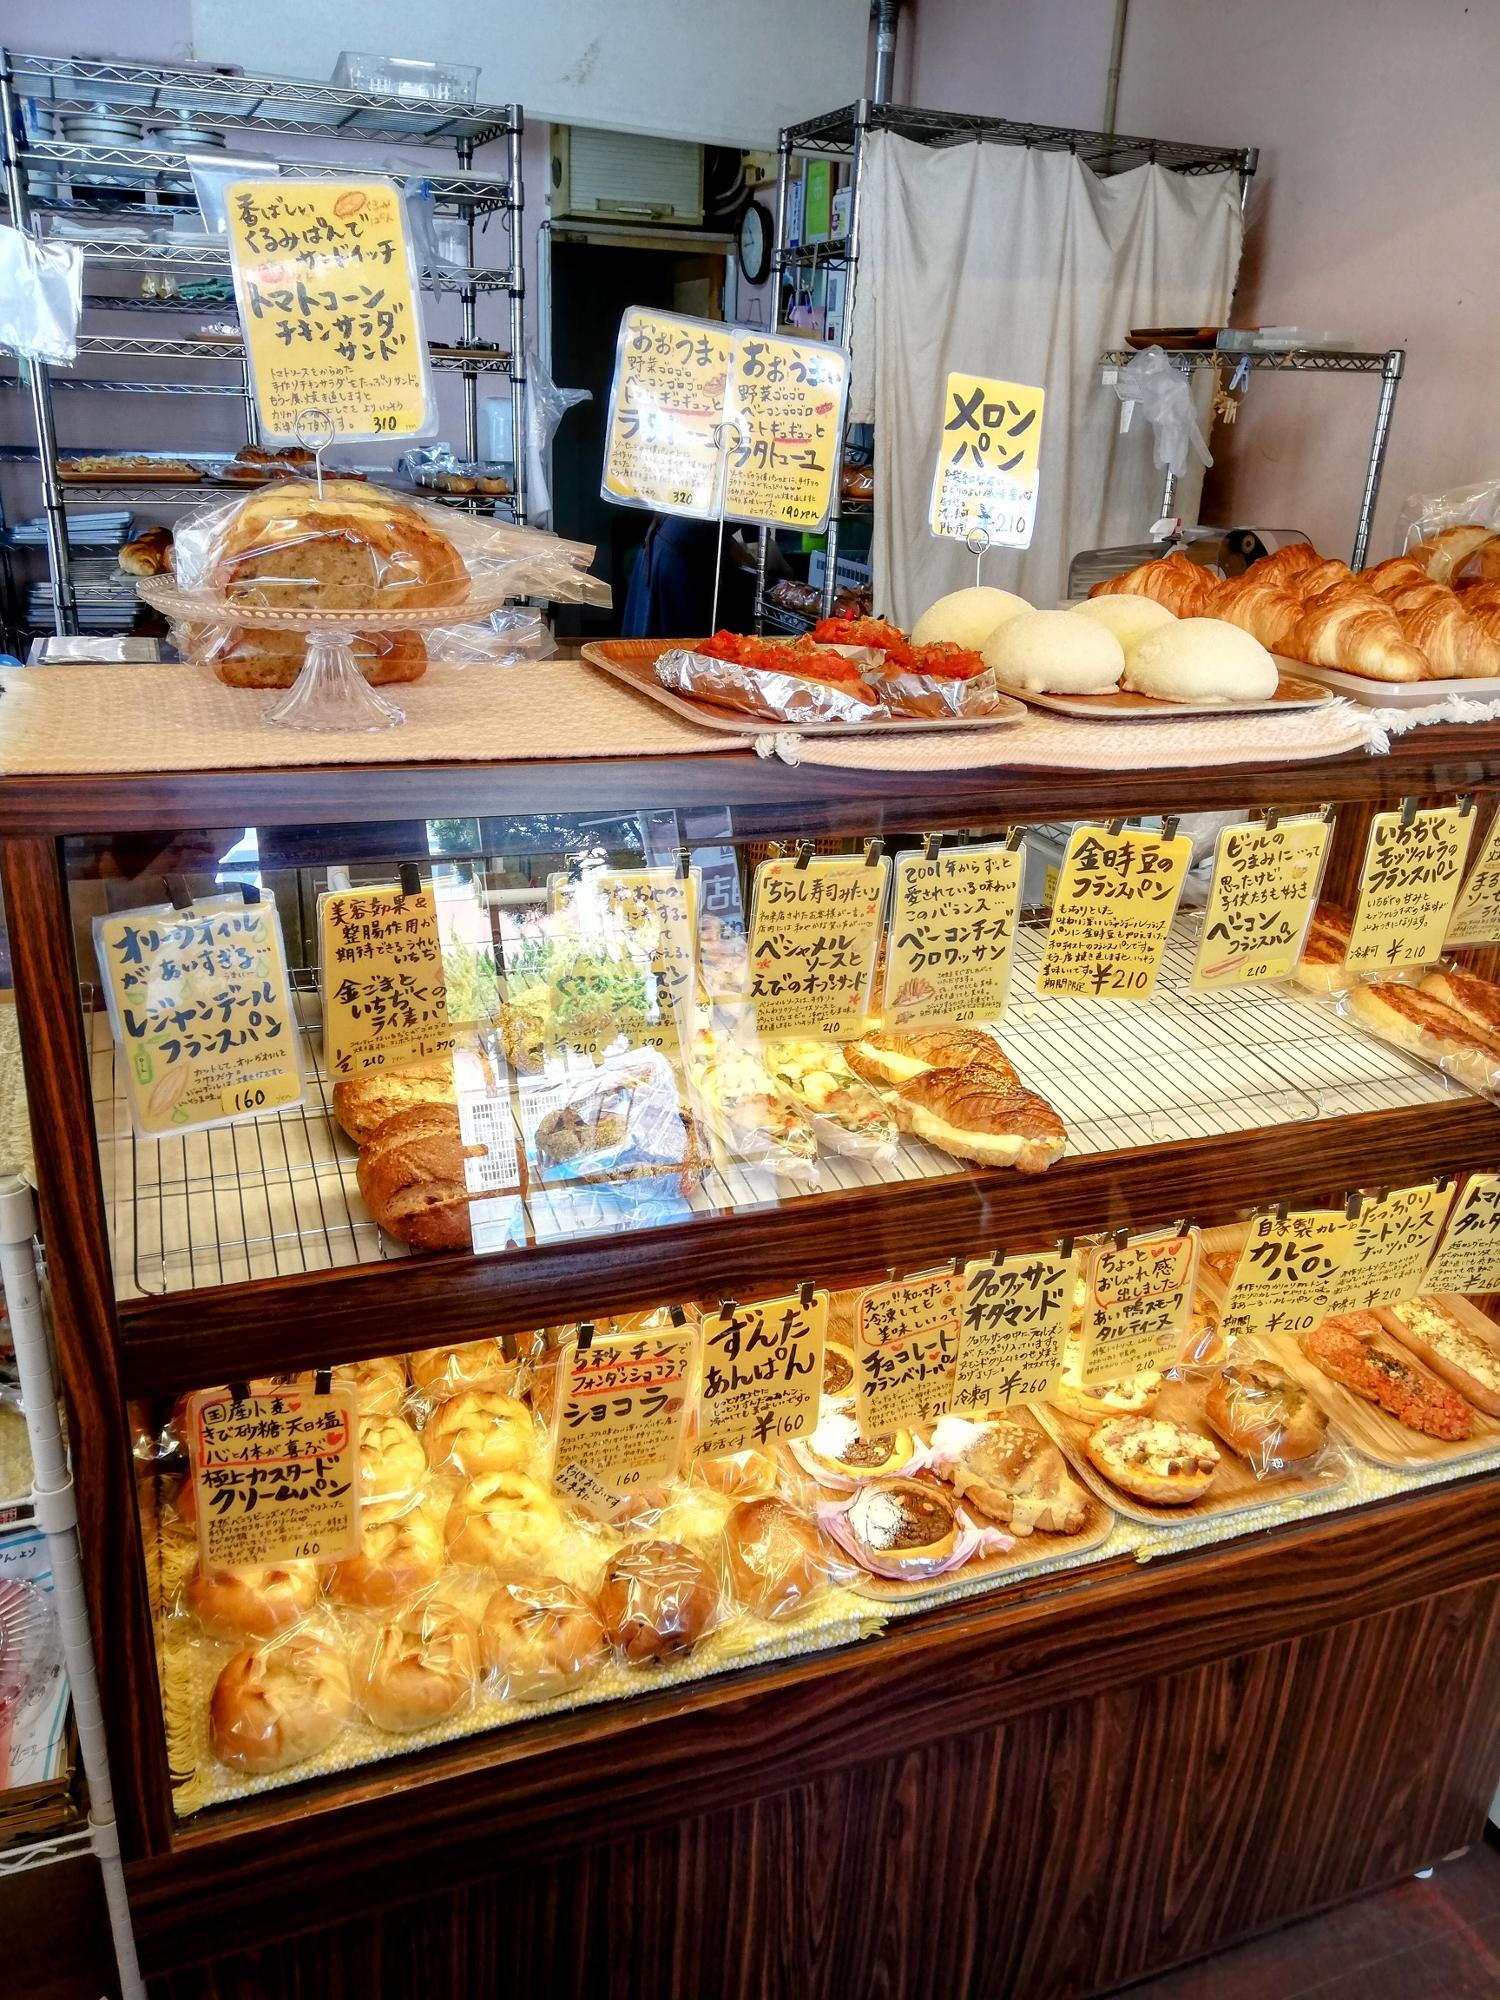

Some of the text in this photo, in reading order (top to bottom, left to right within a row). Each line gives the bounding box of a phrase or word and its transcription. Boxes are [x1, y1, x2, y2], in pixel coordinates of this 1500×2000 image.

[234, 194, 315, 227] 香ばしい
[244, 213, 370, 254] くるみぱんで
[249, 282, 386, 319] トマトコーン
[275, 302, 404, 345] チキンサラダ
[335, 333, 406, 362] サンド
[738, 384, 805, 403] 野菜ゴロゴロ
[373, 415, 397, 434] 310
[741, 404, 813, 418] ベーコンゴロゴロ
[944, 387, 1037, 437] メロン
[951, 432, 1026, 471] パン
[1227, 832, 1285, 858] ビールの
[1375, 817, 1457, 847] いちぢくと
[1071, 836, 1174, 878] 金時豆の
[1072, 875, 1175, 901] フランスパン
[1369, 860, 1459, 894] フランスパン
[904, 882, 1016, 906] 愛されている味わい
[1221, 881, 1308, 912] 子供たちも好き
[342, 913, 437, 945] 整腸作用が
[897, 909, 1014, 949] ベーコンチーズ
[1207, 910, 1282, 941] ベーコン
[1227, 921, 1299, 955] フランスパン
[755, 933, 857, 959] ベシャメル
[908, 946, 1006, 973] クロワッサン
[1386, 938, 1426, 964] ¥210
[806, 952, 863, 972] ソースと
[1247, 964, 1268, 978] 210
[333, 974, 417, 1004] 金ごまと
[1090, 963, 1148, 996] ¥210
[352, 986, 447, 1019] いちぢくの
[955, 1011, 974, 1021] 210
[159, 1010, 282, 1064] フランスパン
[823, 1022, 840, 1033] 210
[362, 1054, 385, 1067] 210
[574, 1042, 596, 1054] 210
[234, 1089, 266, 1112] 160
[1361, 1192, 1431, 1226] たっぷり
[1354, 1211, 1434, 1246] ミートソース
[1101, 1249, 1148, 1274] ちょっと
[1250, 1241, 1325, 1269] カレー
[1267, 1256, 1341, 1281] パン
[967, 1262, 1067, 1306] クロワッサン
[1117, 1278, 1180, 1301] 出しました
[1363, 1288, 1402, 1307] ¥210
[864, 1299, 934, 1330] 冷凍しても
[1093, 1293, 1184, 1327] あい鴨スモーク
[1265, 1311, 1314, 1333] ¥210
[707, 1299, 818, 1361] ずんだ
[878, 1308, 957, 1344] 美味しいって
[1095, 1313, 1174, 1342] タルティーヌ
[862, 1330, 957, 1378] チョコレート
[1136, 1359, 1155, 1373] 210
[704, 1344, 815, 1399] あんぱん
[999, 1370, 1047, 1405] ¥260
[202, 1398, 290, 1425] 国産小麦
[564, 1387, 669, 1428] ショコラ
[751, 1411, 804, 1445] ¥160
[202, 1455, 340, 1488] 極上カスタード
[616, 1471, 640, 1486] 160
[208, 1478, 352, 1515] クリームパン
[295, 1543, 320, 1557] 160
